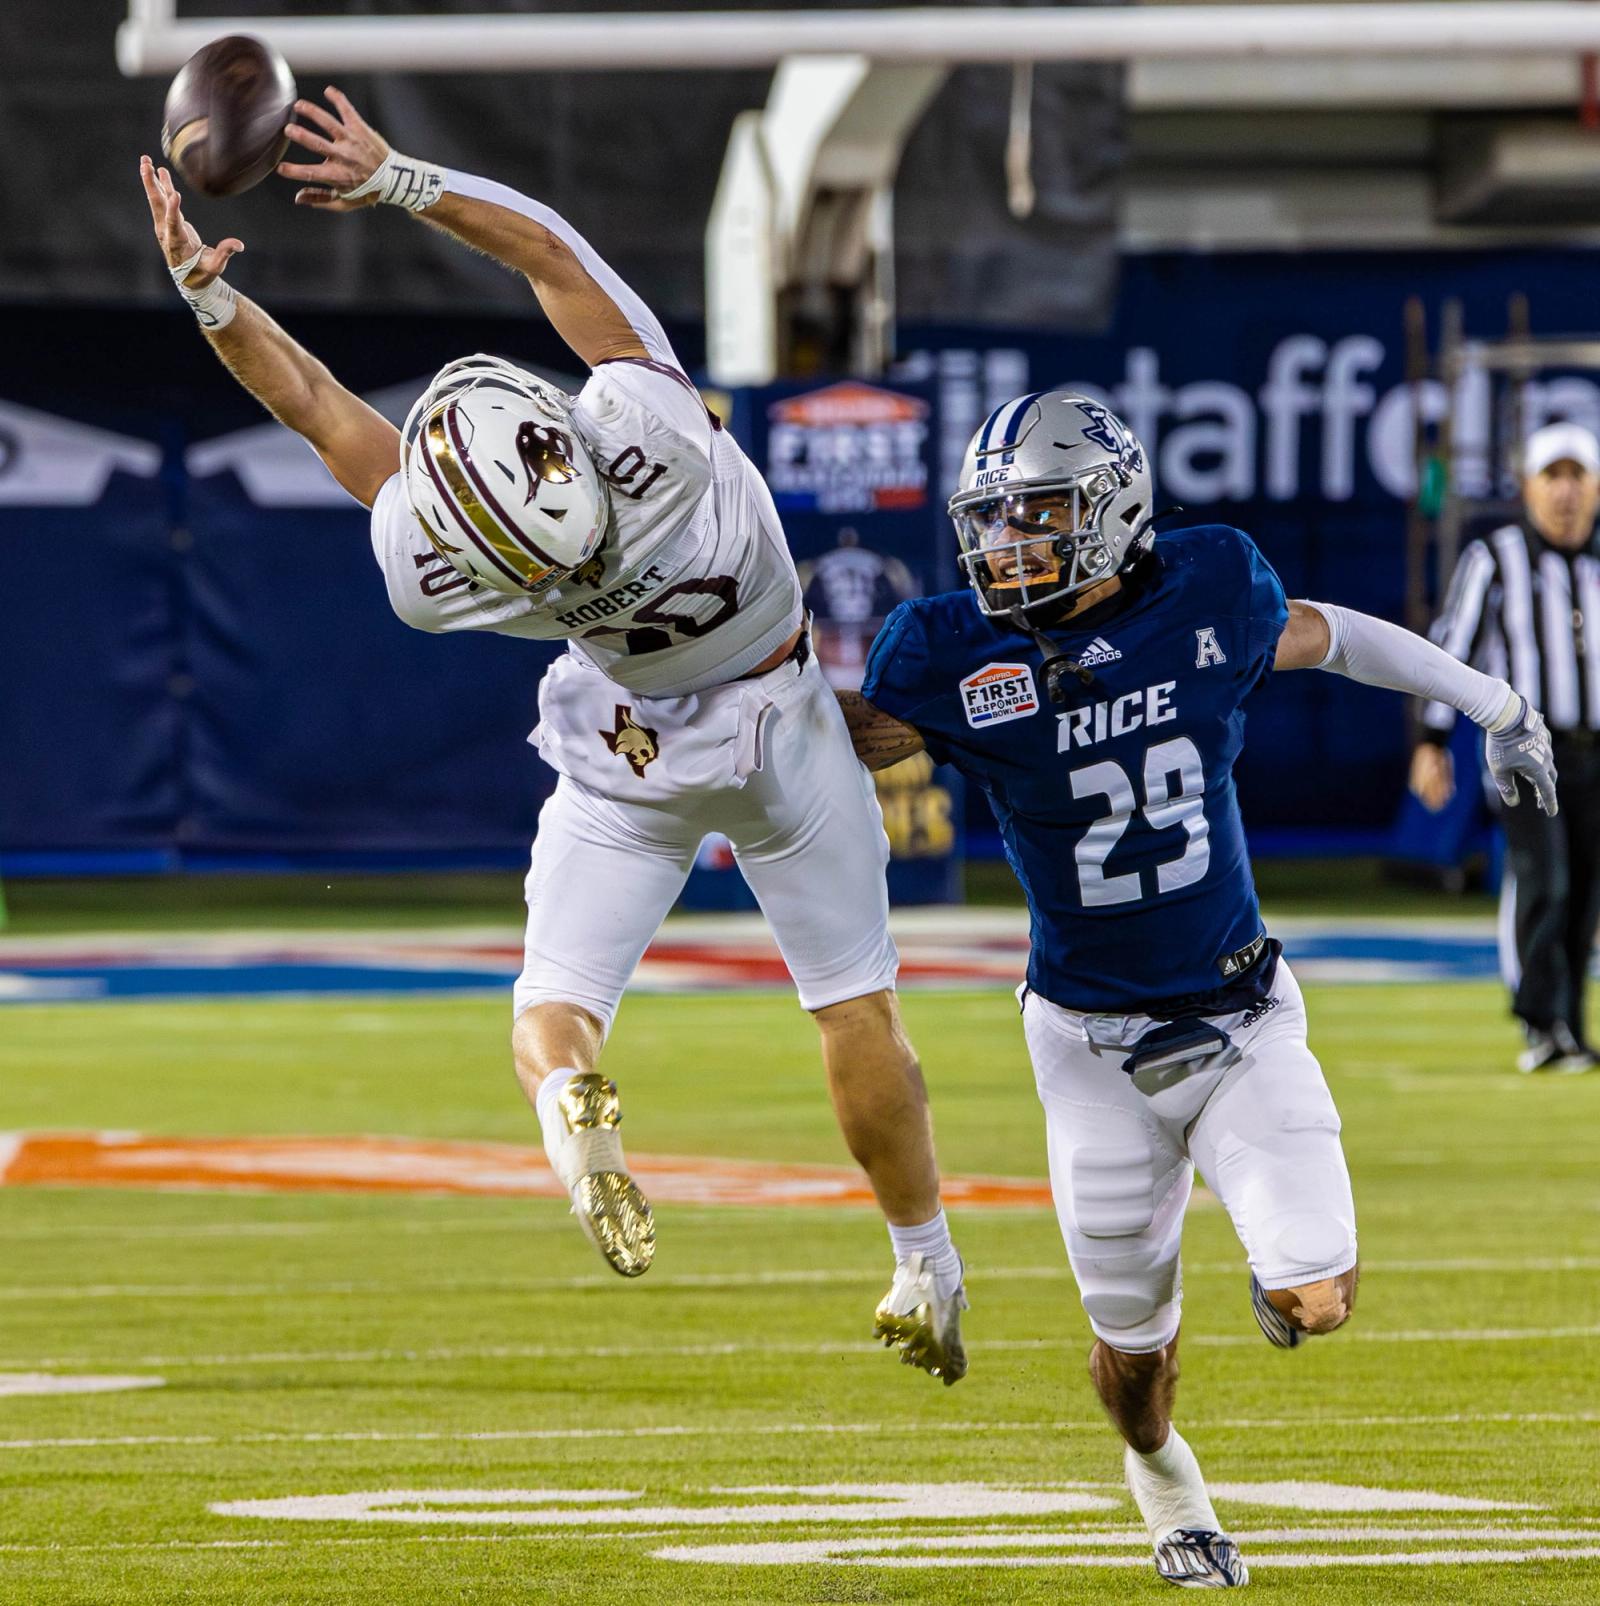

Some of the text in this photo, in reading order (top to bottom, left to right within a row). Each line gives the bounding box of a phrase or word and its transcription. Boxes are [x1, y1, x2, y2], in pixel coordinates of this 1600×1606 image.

[976, 467, 1010, 488] RICE
[555, 564, 667, 629] HOBERT
[1078, 650, 1122, 667] adidas
[969, 693, 1033, 715] RESPONDER
[992, 708, 1015, 718] BOWL
[1055, 680, 1177, 753] RICE
[1069, 736, 1210, 907] 29
[1242, 997, 1280, 1028] adidas
